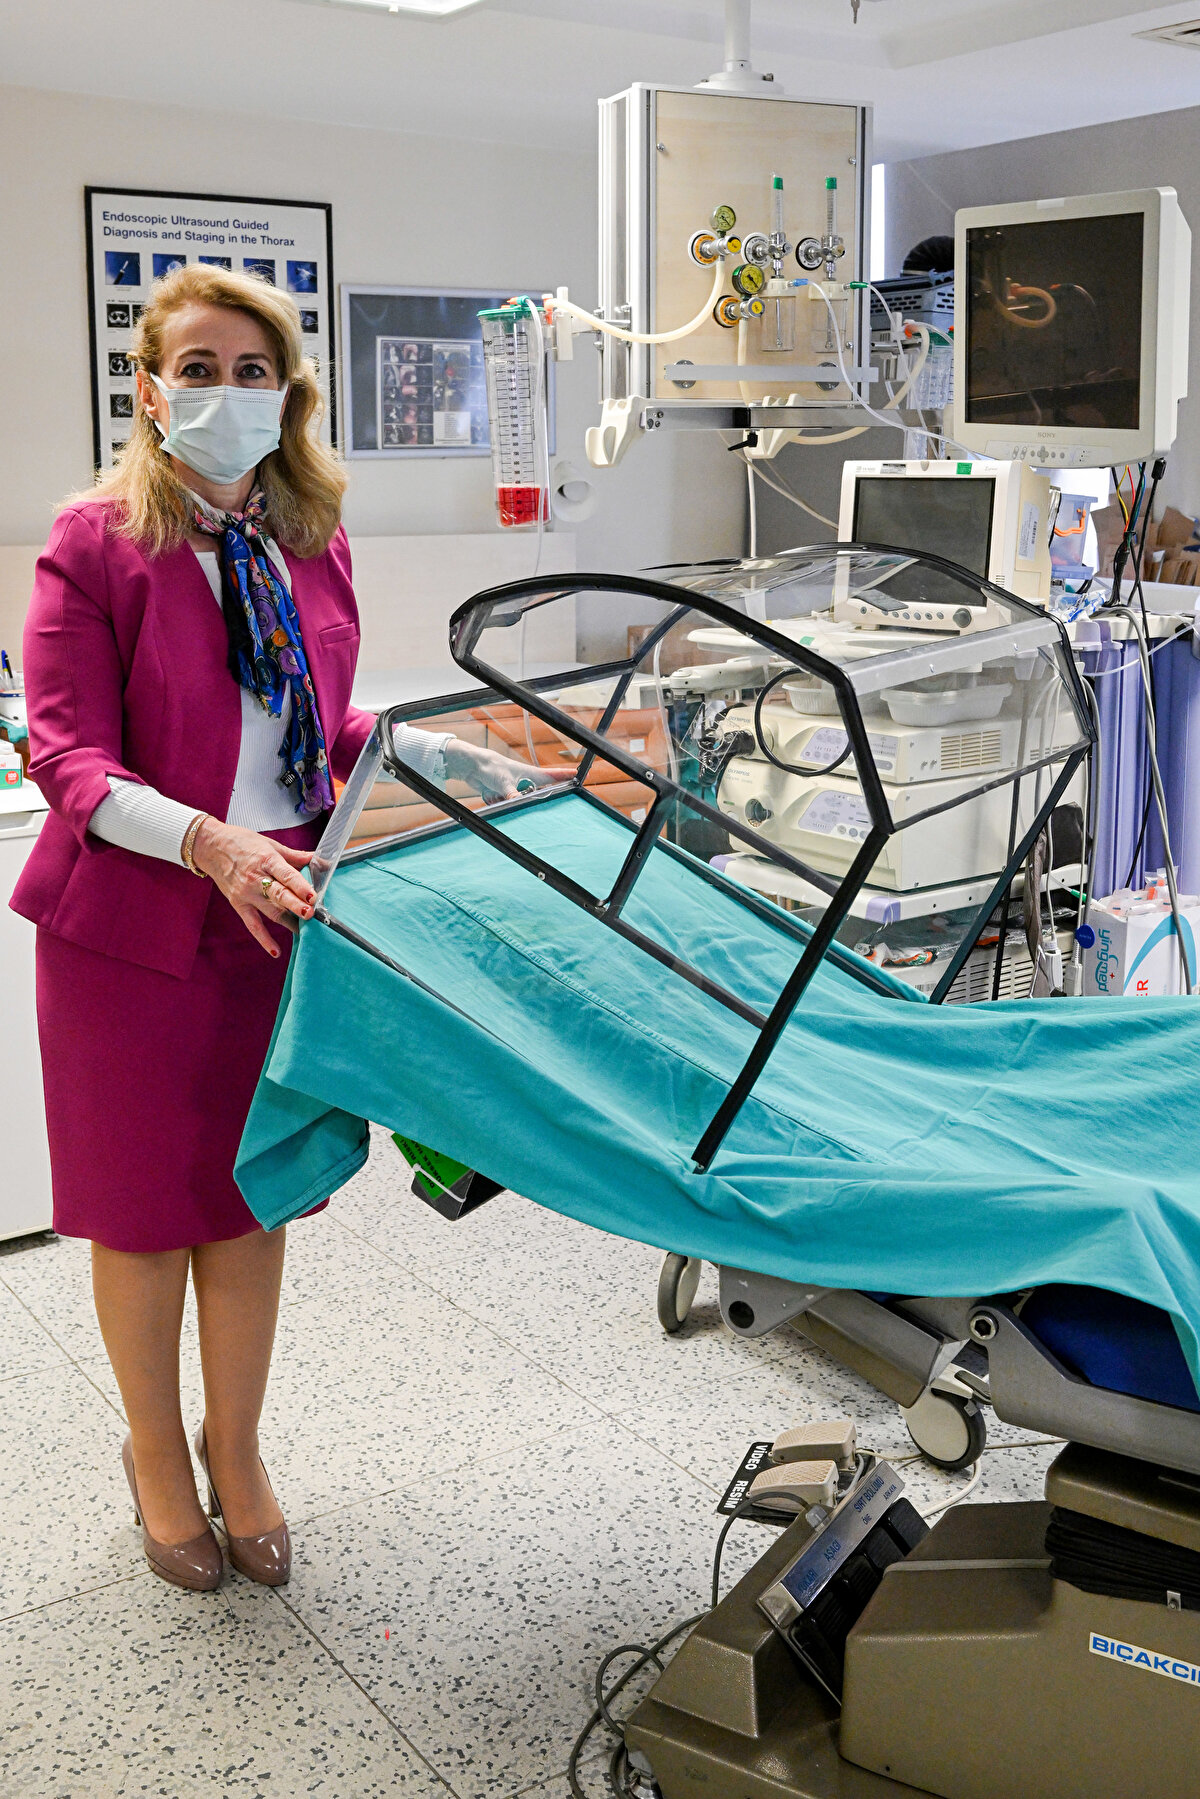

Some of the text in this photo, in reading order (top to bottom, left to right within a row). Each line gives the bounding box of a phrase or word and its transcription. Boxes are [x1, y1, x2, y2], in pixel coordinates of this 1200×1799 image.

[102, 211, 270, 231] Endoscopic Ultrasound Guided
[103, 226, 295, 247] Diagnosis and Staging in the Thorax
[1037, 431, 1057, 439] SONY
[729, 715, 751, 723] OLYMPUS
[727, 768, 750, 776] OLYMPUS
[1095, 928, 1115, 992] yingmed
[723, 1480, 749, 1509] RESİM
[1092, 1636, 1200, 1684] BIÇAKCI
